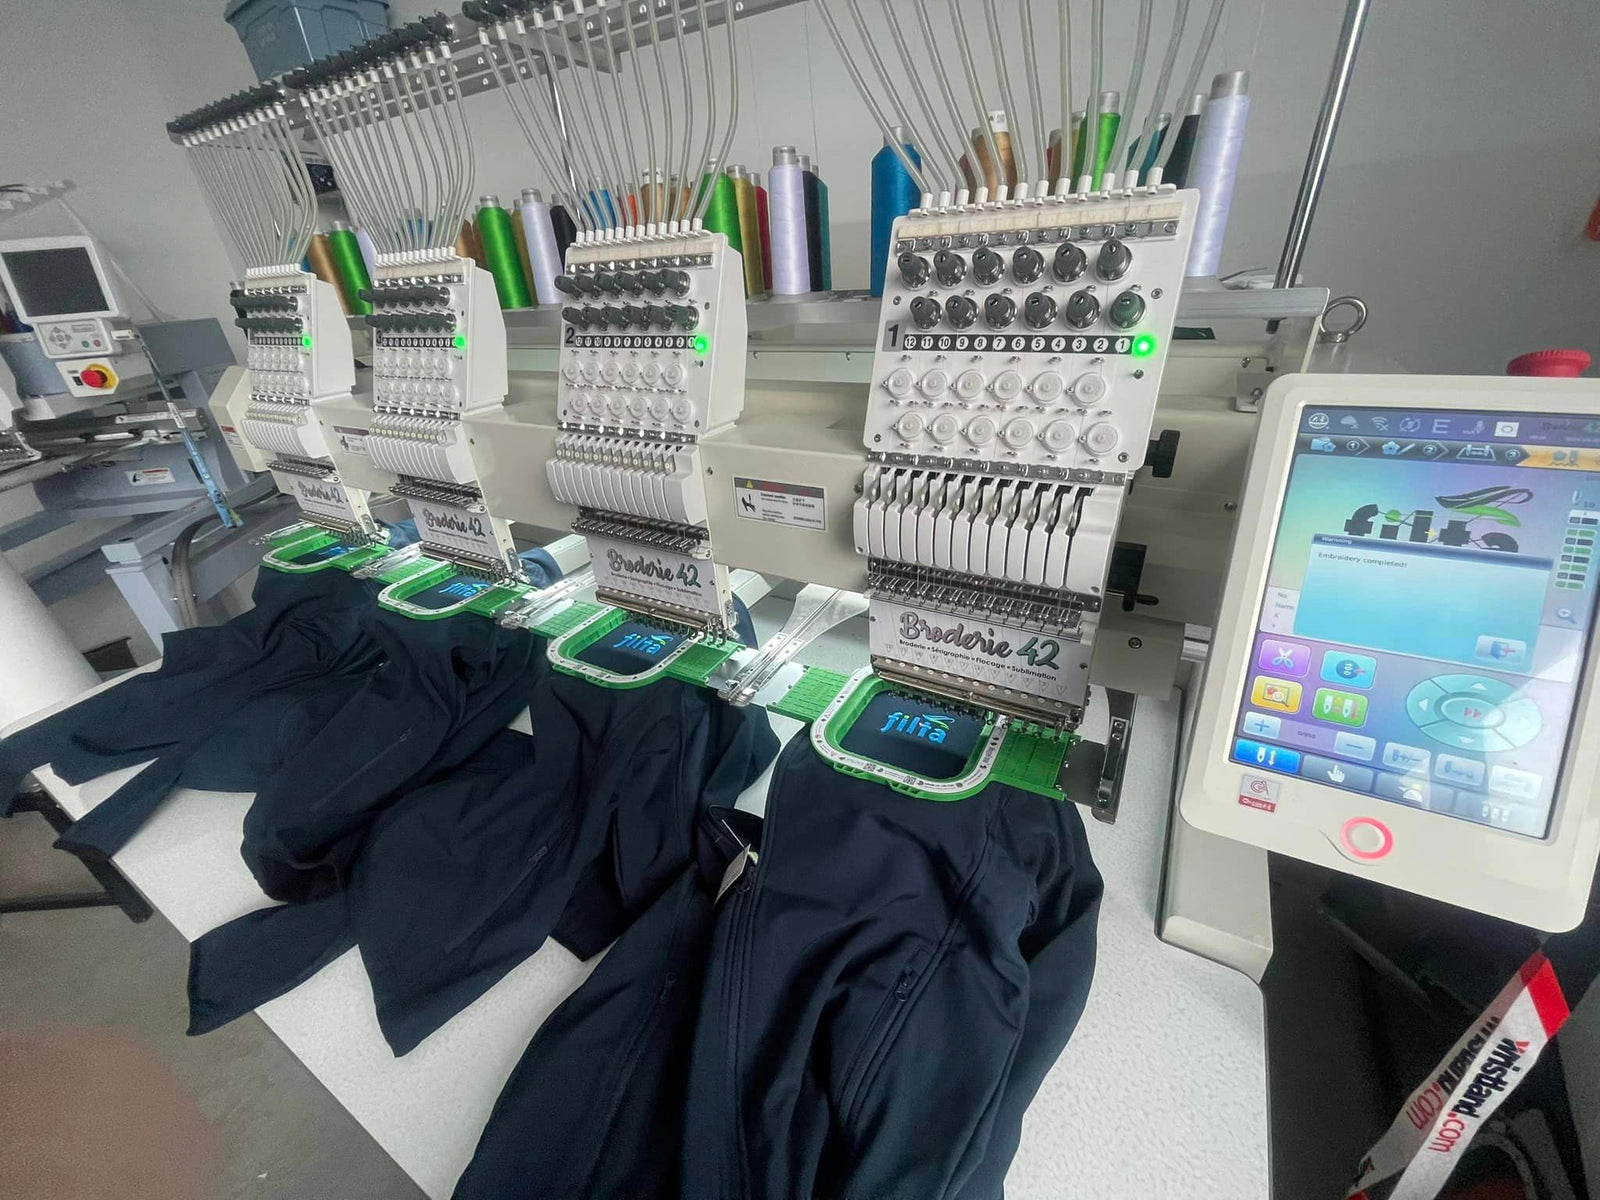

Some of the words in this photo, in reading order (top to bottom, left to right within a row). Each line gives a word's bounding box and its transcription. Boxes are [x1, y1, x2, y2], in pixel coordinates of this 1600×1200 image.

[565, 327, 575, 344] 2
[888, 324, 899, 347] 1
[1432, 418, 1452, 434] E
[1318, 552, 1361, 562] Embroidery
[607, 548, 674, 582] Broderie
[675, 563, 702, 588] 42
[899, 639, 926, 650] Broderie
[900, 611, 1013, 659] Broderie
[1016, 636, 1060, 671] 42
[880, 712, 947, 744] filta
